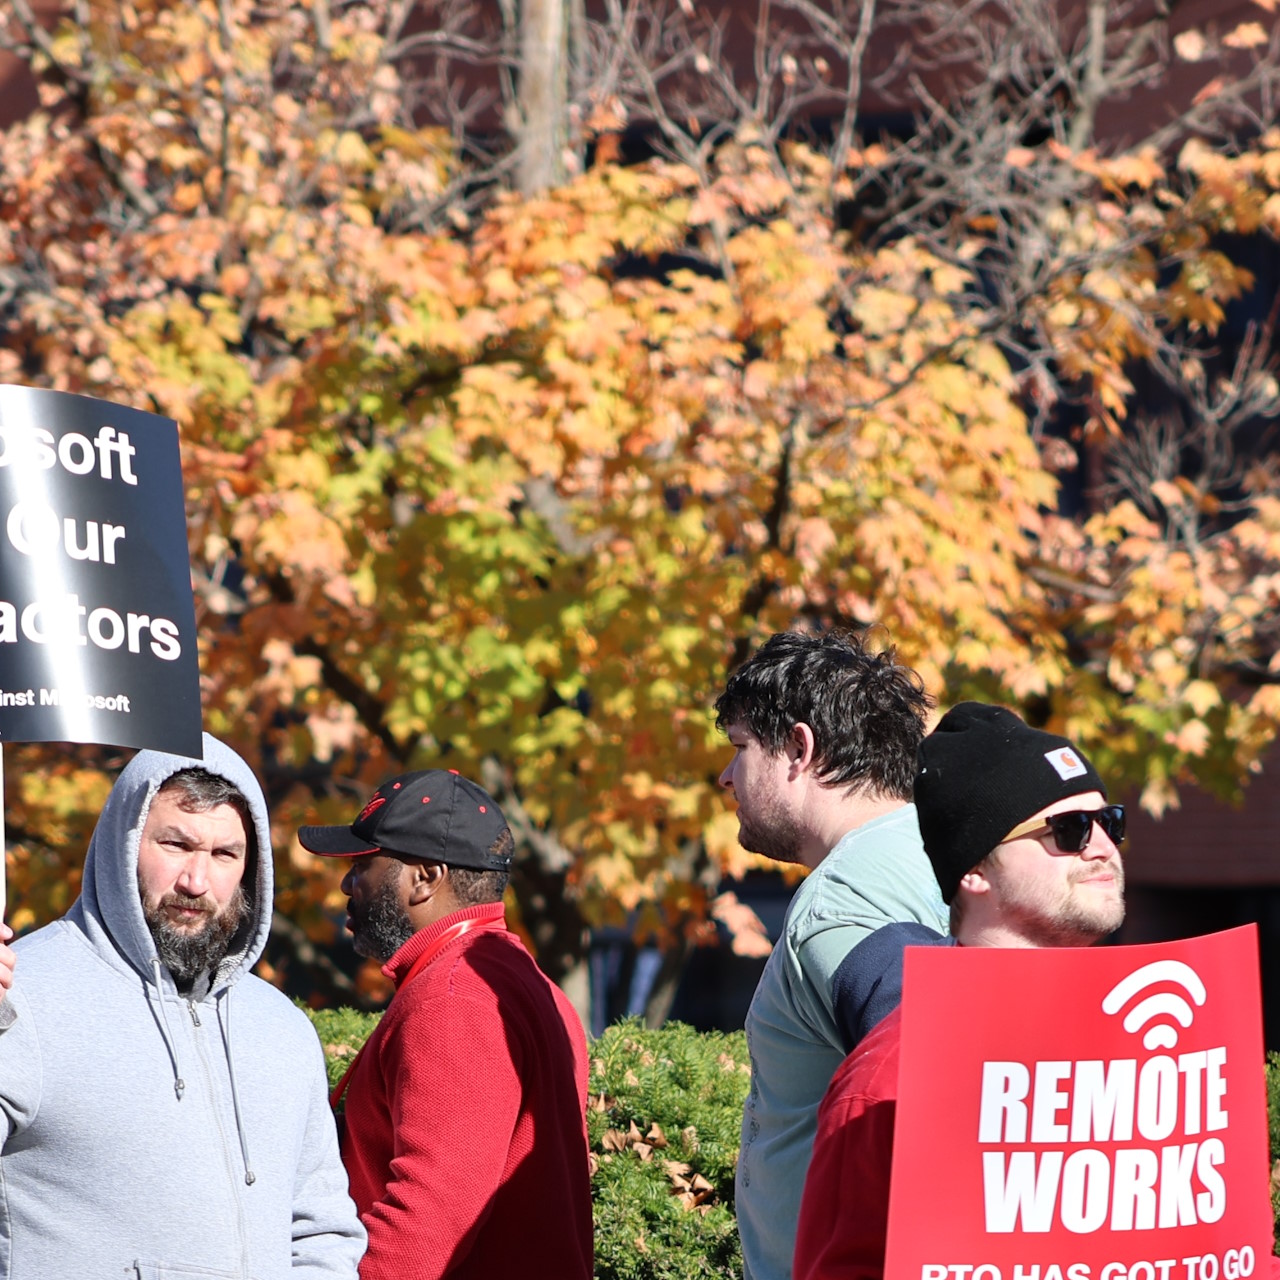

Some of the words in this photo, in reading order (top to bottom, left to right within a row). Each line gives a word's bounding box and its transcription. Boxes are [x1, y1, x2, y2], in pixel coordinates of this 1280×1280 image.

[6, 501, 126, 564] Our
[977, 1046, 1229, 1144] REMOTE
[982, 1138, 1227, 1234] WORKS
[1223, 1245, 1256, 1280] GO
